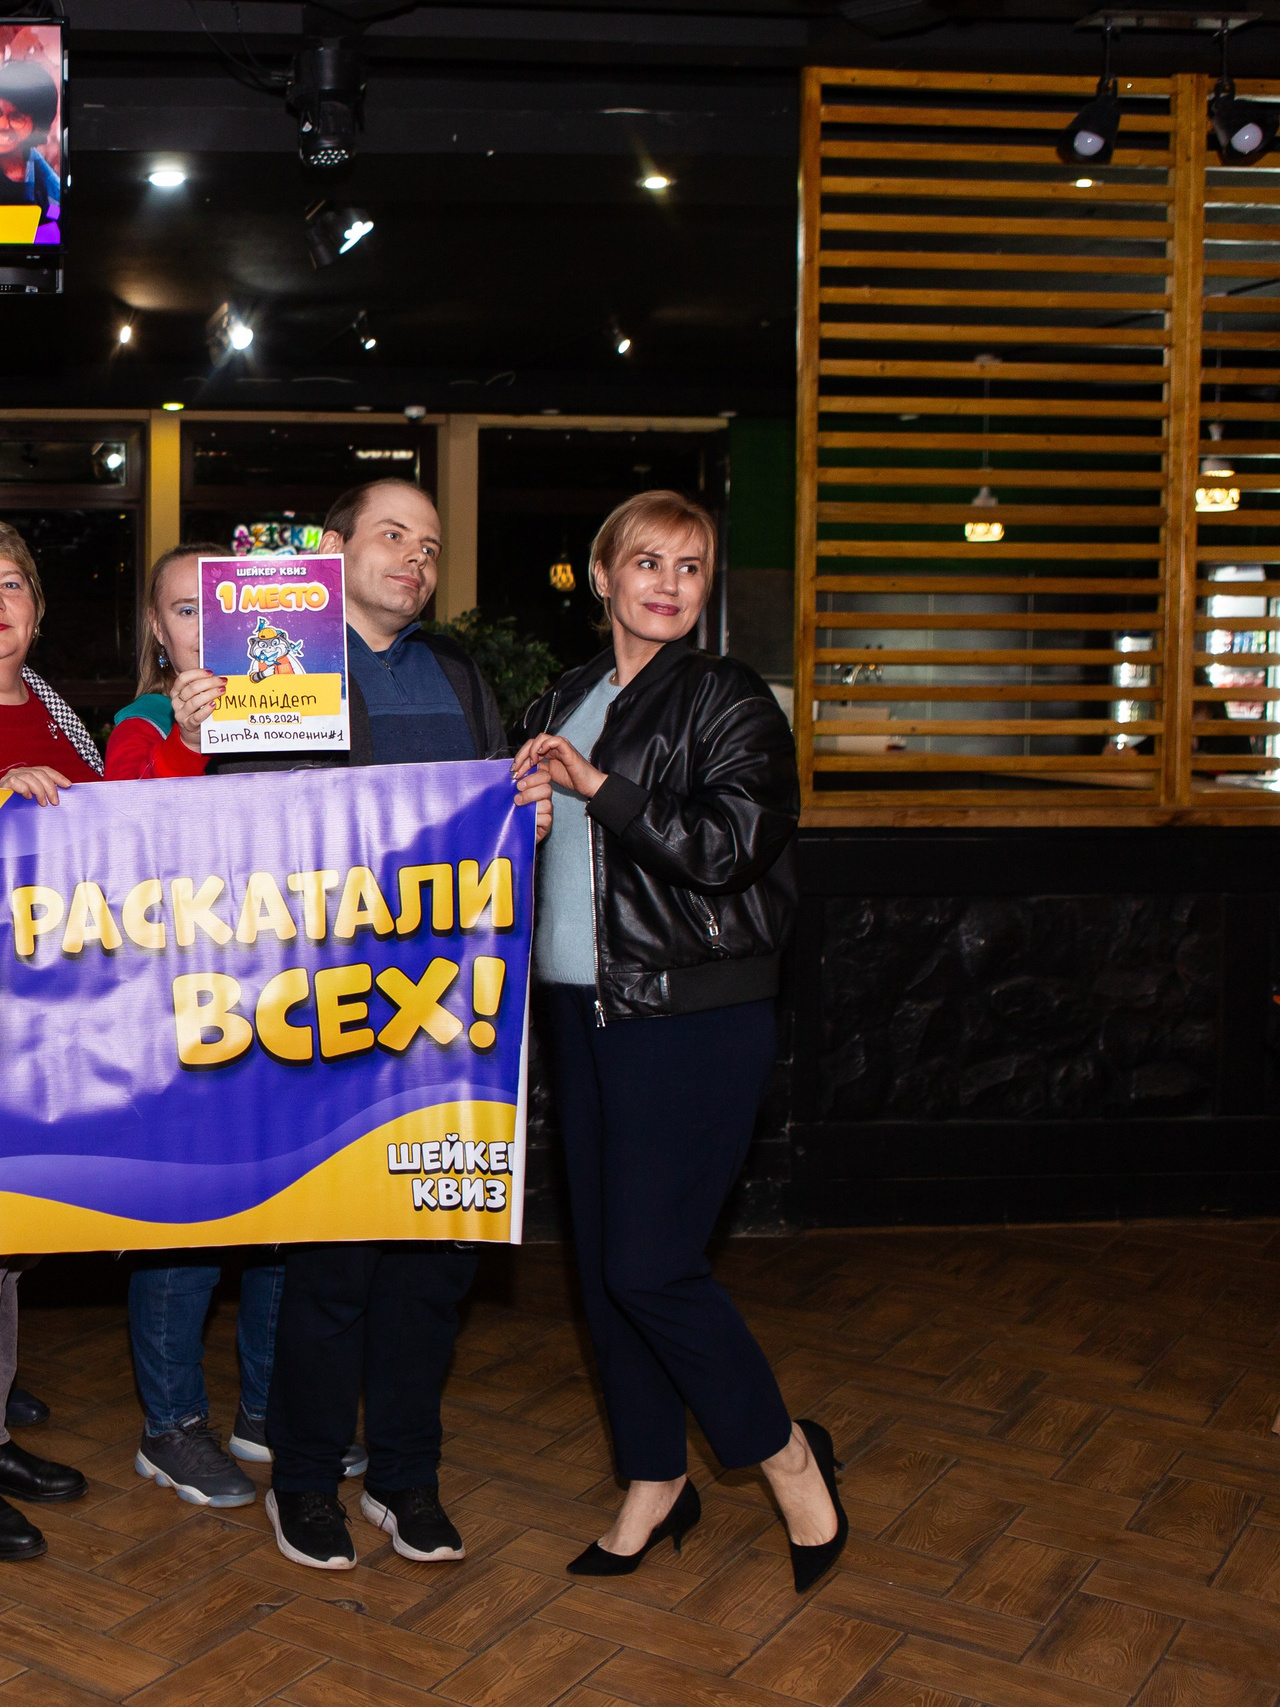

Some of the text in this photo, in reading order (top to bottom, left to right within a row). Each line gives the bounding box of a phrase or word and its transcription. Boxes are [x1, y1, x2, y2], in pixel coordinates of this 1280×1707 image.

[232, 522, 324, 549] ДЕТСКИ
[236, 566, 307, 577] ШЕЙКЕР КВИЗ
[217, 582, 328, 612] 1 МЕСТО
[11, 857, 516, 963] РАСКАТАЛИ
[171, 955, 507, 1072] ВСЕХ!
[411, 1177, 507, 1212] КВИЗ
